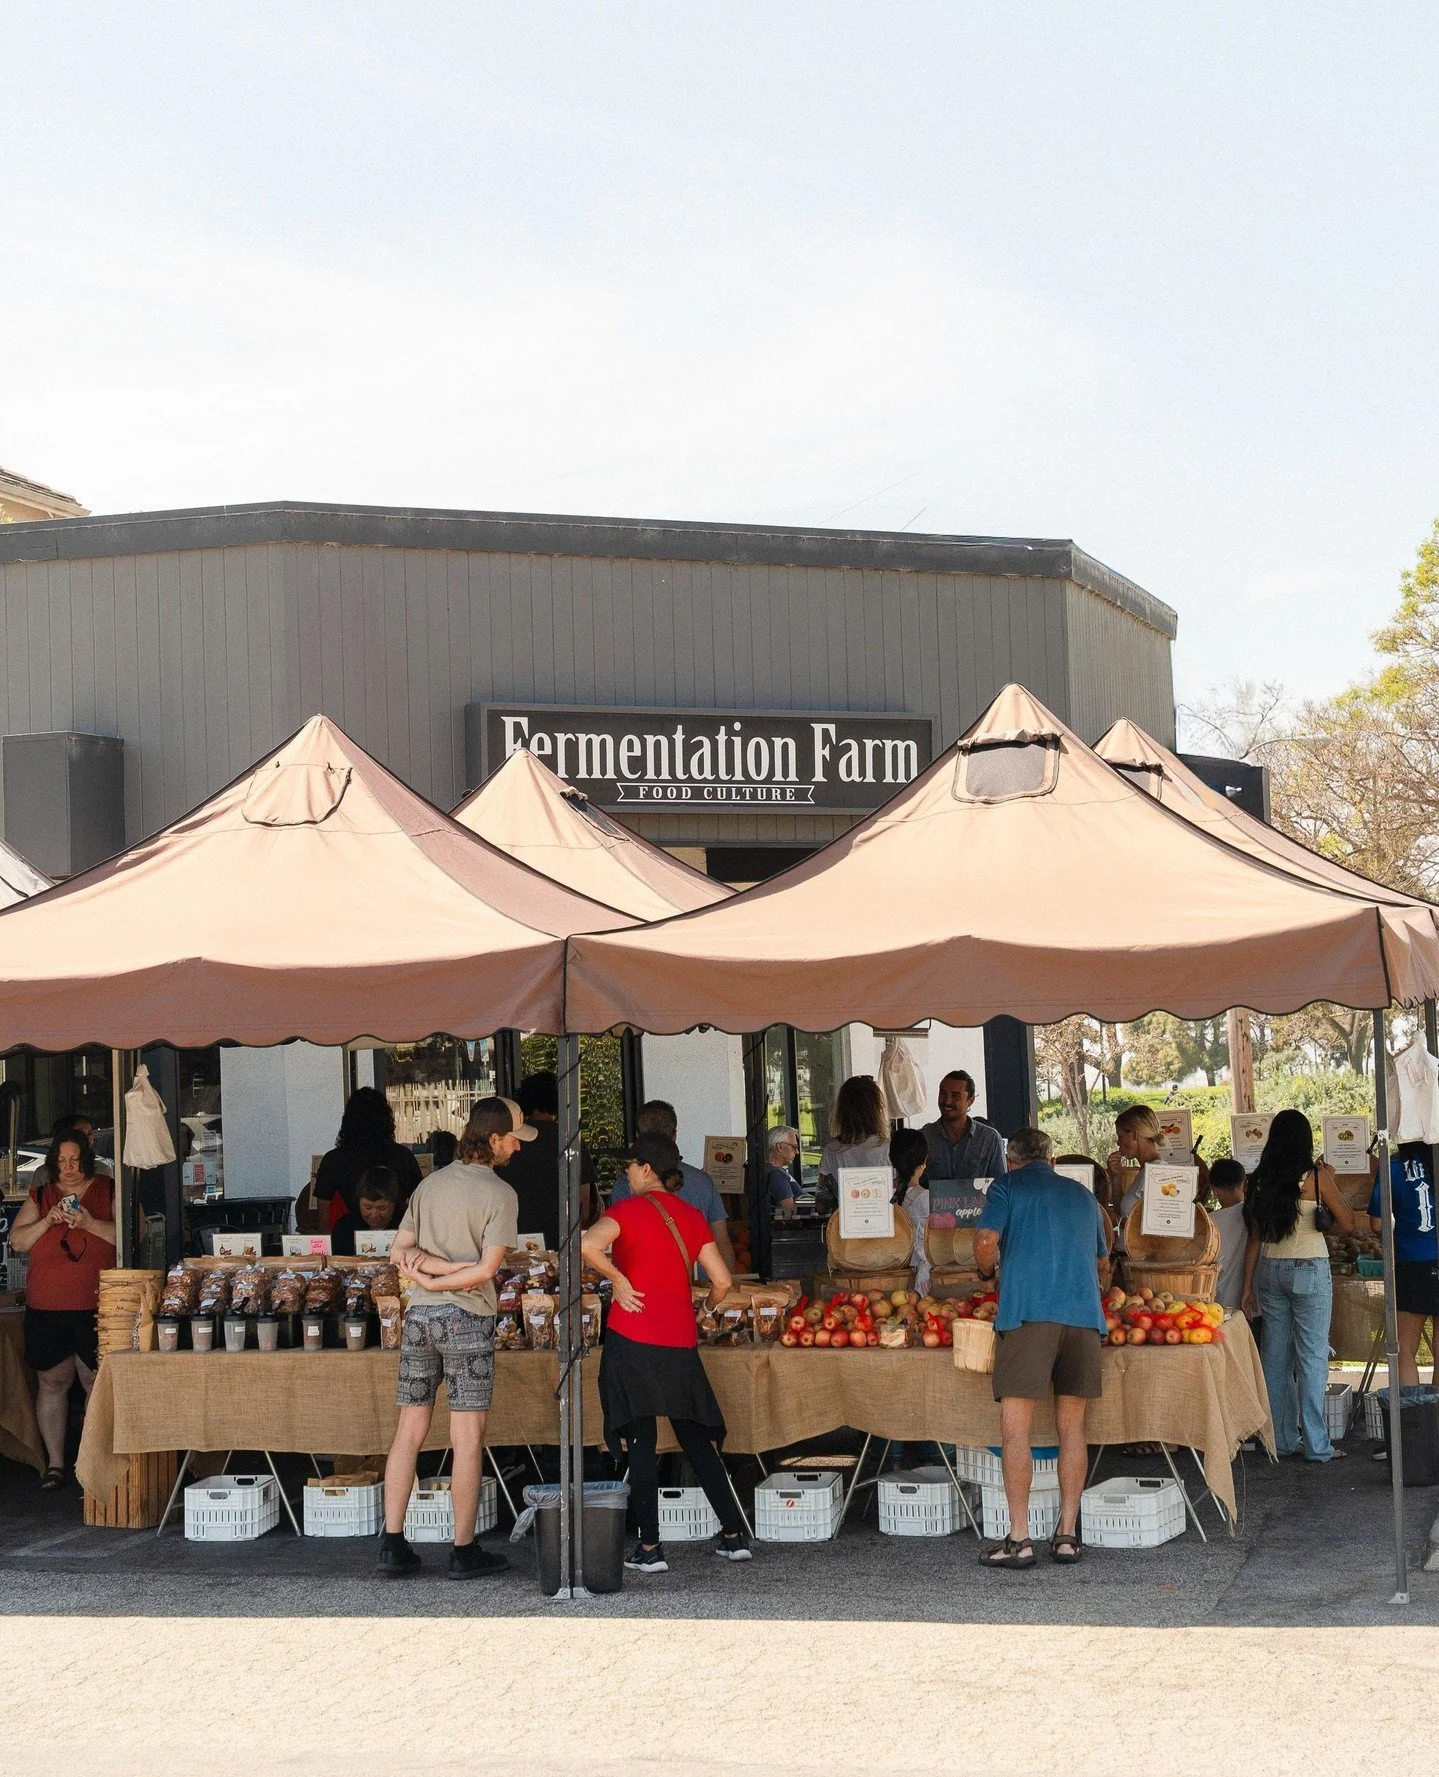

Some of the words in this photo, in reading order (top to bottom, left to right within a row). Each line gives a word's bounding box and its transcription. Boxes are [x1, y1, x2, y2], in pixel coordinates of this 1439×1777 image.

[501, 716, 799, 782] Fermentation
[810, 723, 918, 783] Farm
[638, 786, 692, 799] FOOD
[703, 787, 796, 800] CULTURE
